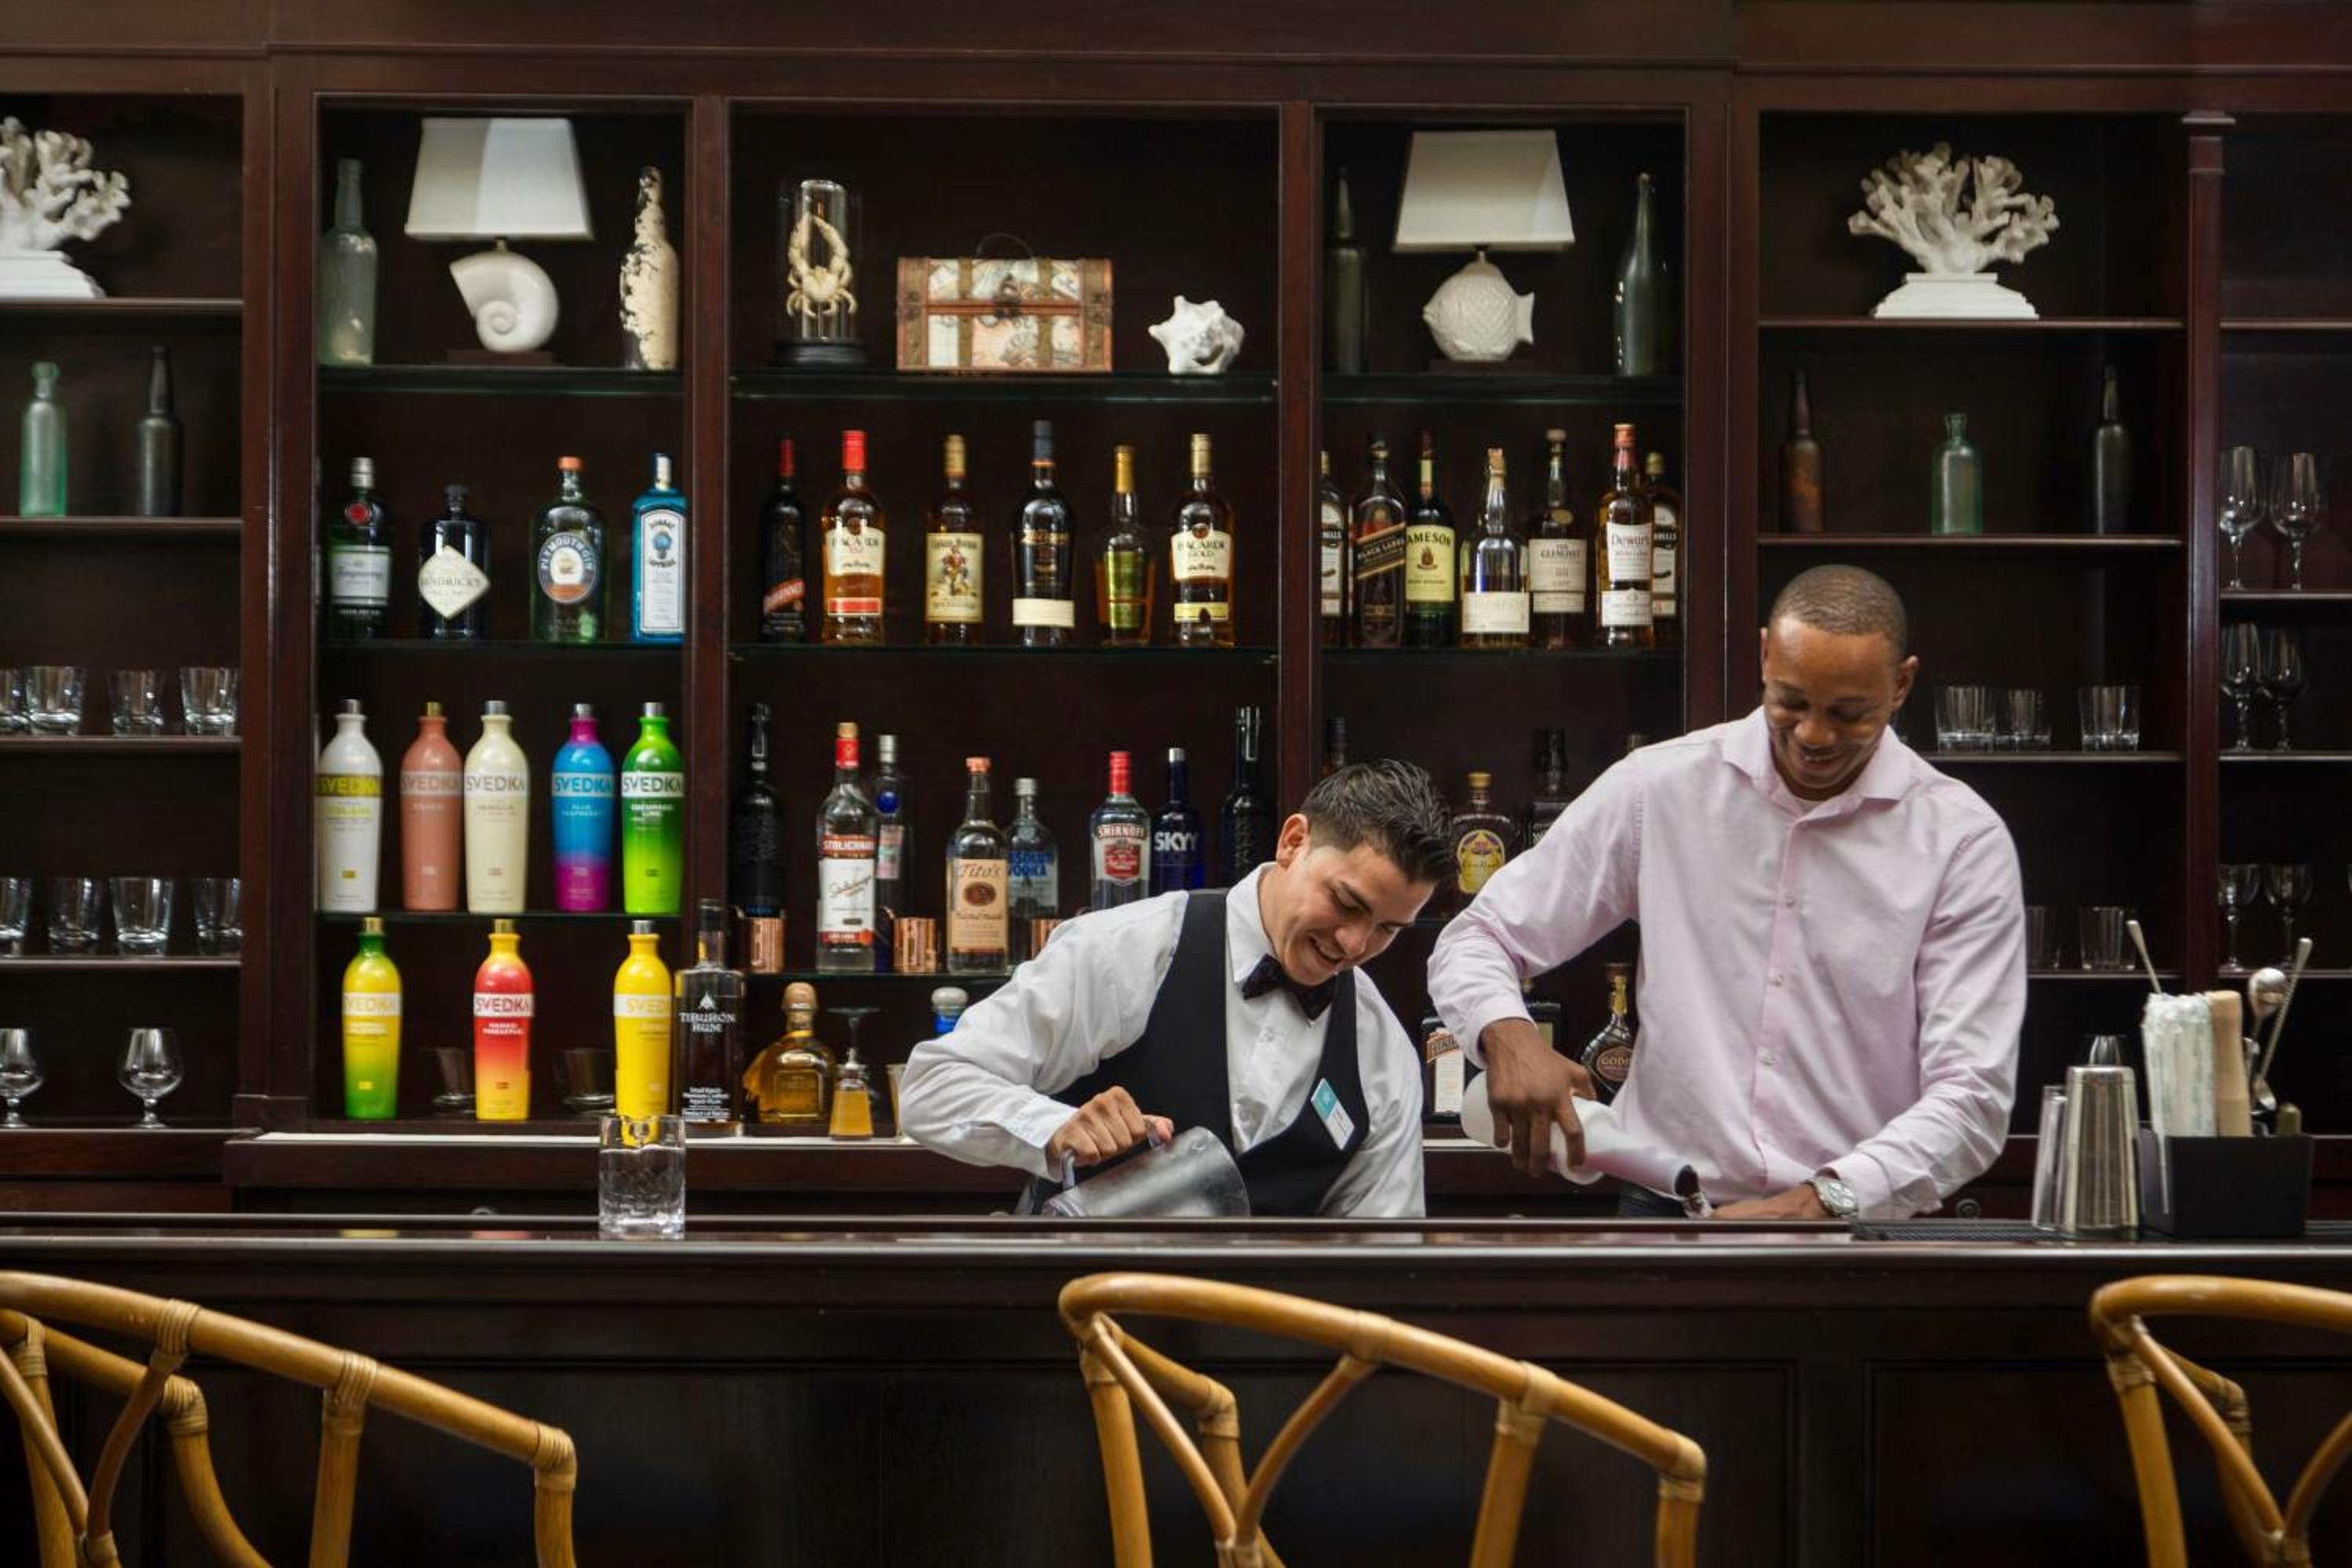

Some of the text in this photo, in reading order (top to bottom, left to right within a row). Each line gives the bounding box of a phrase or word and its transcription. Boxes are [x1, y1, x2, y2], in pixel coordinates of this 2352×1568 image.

[1407, 532, 1451, 546] AMESON
[541, 535, 593, 571] PLYMOUTH GIN
[401, 775, 460, 792] SVEDKA
[466, 776, 525, 792] SVEDKA
[554, 777, 613, 792] SVEDKA
[622, 776, 682, 792] SVEDKA
[1098, 826, 1145, 838] SMIRNOFF
[1154, 831, 1200, 851] SKYY
[960, 862, 1001, 879] Tito's
[475, 998, 529, 1012] SVEDKA
[692, 1023, 721, 1033] RUM
[1601, 1056, 1631, 1067] GODI
